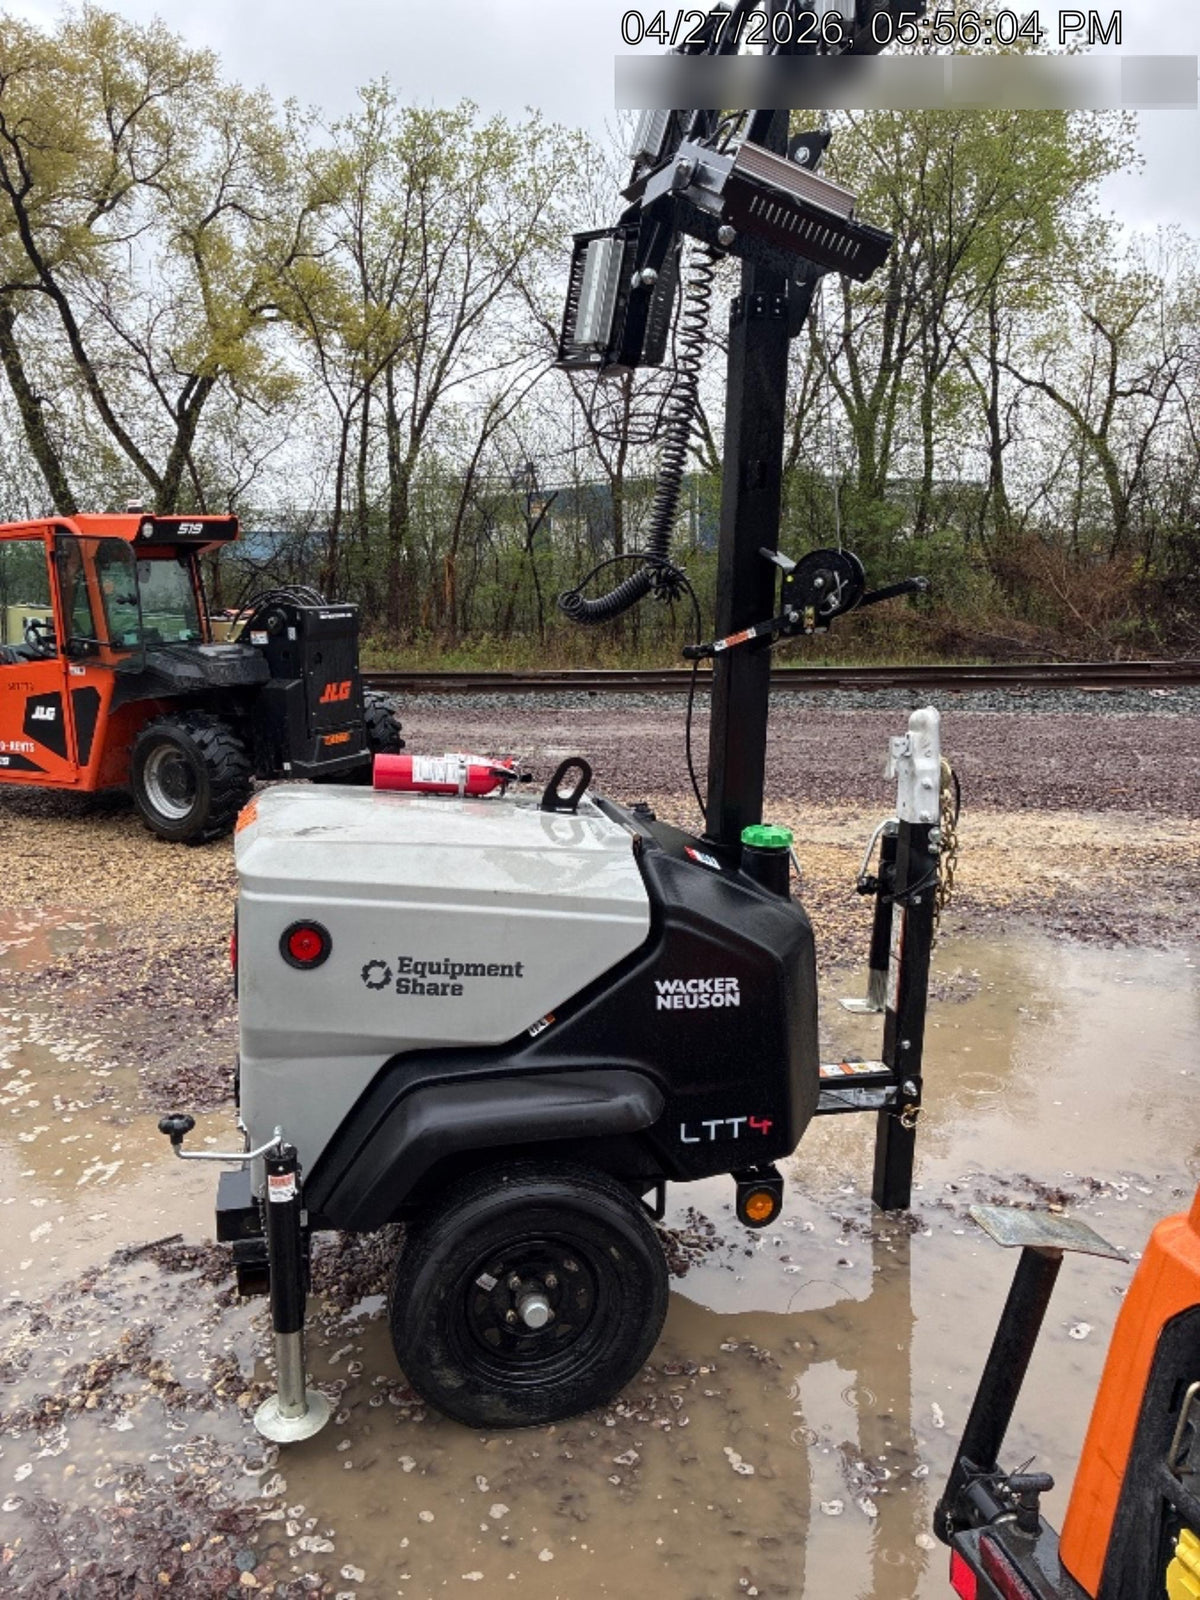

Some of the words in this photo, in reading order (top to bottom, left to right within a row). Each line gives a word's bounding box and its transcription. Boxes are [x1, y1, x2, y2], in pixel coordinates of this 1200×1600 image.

[177, 522, 204, 535] 519
[319, 681, 352, 704] JLG
[31, 705, 56, 721] JLG
[397, 956, 524, 980] Equipment
[396, 977, 463, 997] Share
[655, 977, 740, 995] WACKER
[656, 992, 740, 1011] NEUSON
[680, 1115, 773, 1144] LTT4
